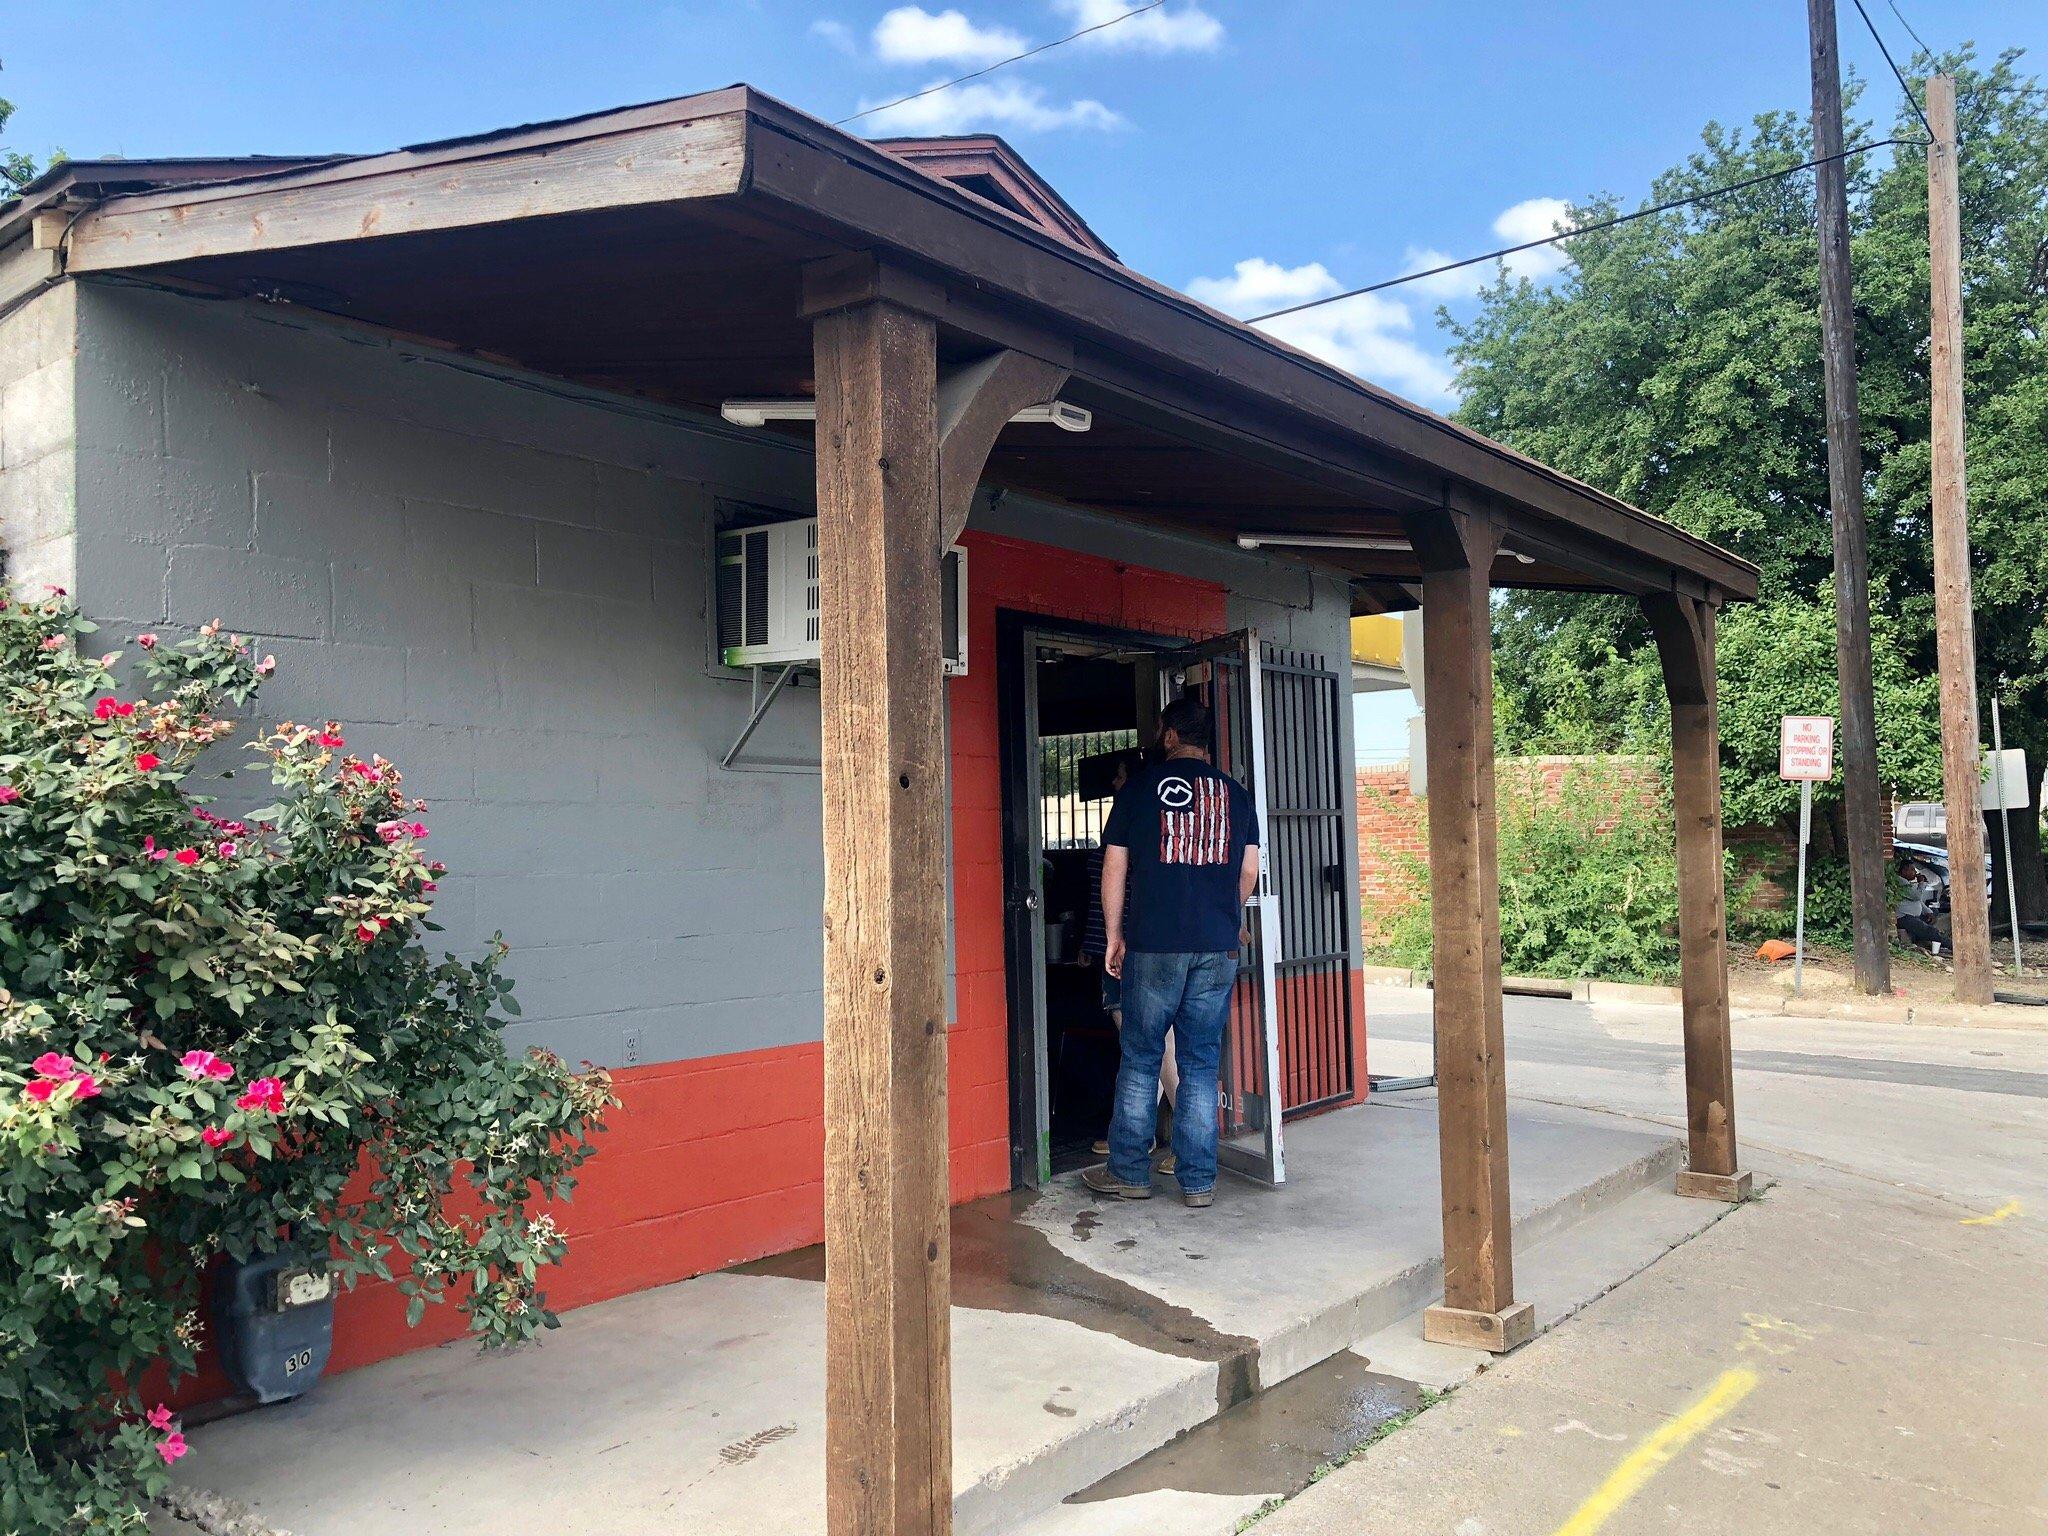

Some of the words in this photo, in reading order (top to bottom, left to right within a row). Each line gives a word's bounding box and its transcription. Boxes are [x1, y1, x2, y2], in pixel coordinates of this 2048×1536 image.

[1803, 723, 1812, 732] NO
[1786, 746, 1816, 755] STOPPING
[1818, 747, 1828, 756] OR
[1791, 757, 1822, 767] STANDING
[288, 1351, 310, 1372] 30
